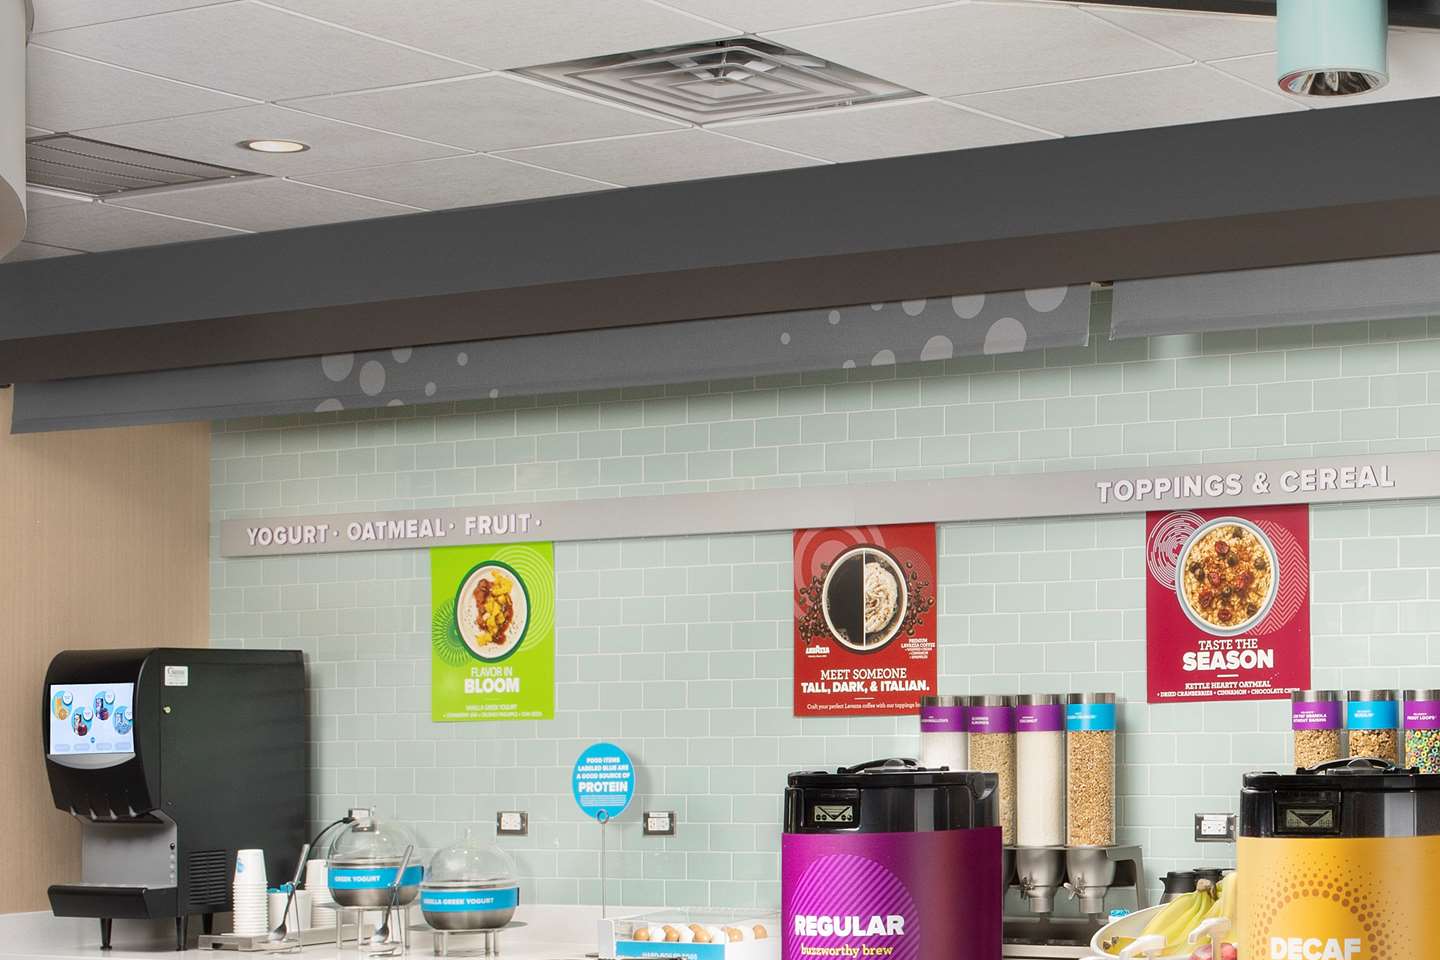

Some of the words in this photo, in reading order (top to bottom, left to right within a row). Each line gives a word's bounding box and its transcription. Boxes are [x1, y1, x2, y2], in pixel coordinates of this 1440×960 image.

[1096, 473, 1242, 504] TOPPINGS
[1252, 472, 1271, 494] &
[1280, 465, 1396, 493] CEREAL
[247, 524, 330, 546] YOGURT
[347, 517, 446, 541] OATMEAL
[465, 513, 532, 536] FRUIT
[1198, 640, 1233, 650] TASTE
[1235, 639, 1258, 650] THE
[1182, 649, 1274, 671] SEASON
[471, 667, 502, 677] FLAVOR
[503, 666, 513, 676] IN
[820, 669, 850, 680] MEET
[853, 667, 907, 679] SOMEONE
[464, 677, 520, 693] BLOOM
[801, 683, 831, 694] TALL,
[832, 682, 868, 693] DARK,
[870, 682, 878, 692] &
[881, 680, 930, 691] ITALIAN.
[1211, 681, 1238, 689] HEARTY
[1239, 680, 1271, 688] OATMEAL
[578, 781, 629, 793] PROTEIN
[794, 915, 905, 937] REGULAR
[801, 944, 860, 959] buzzworthy
[862, 944, 894, 956] brew
[1270, 937, 1361, 960] DECAF
